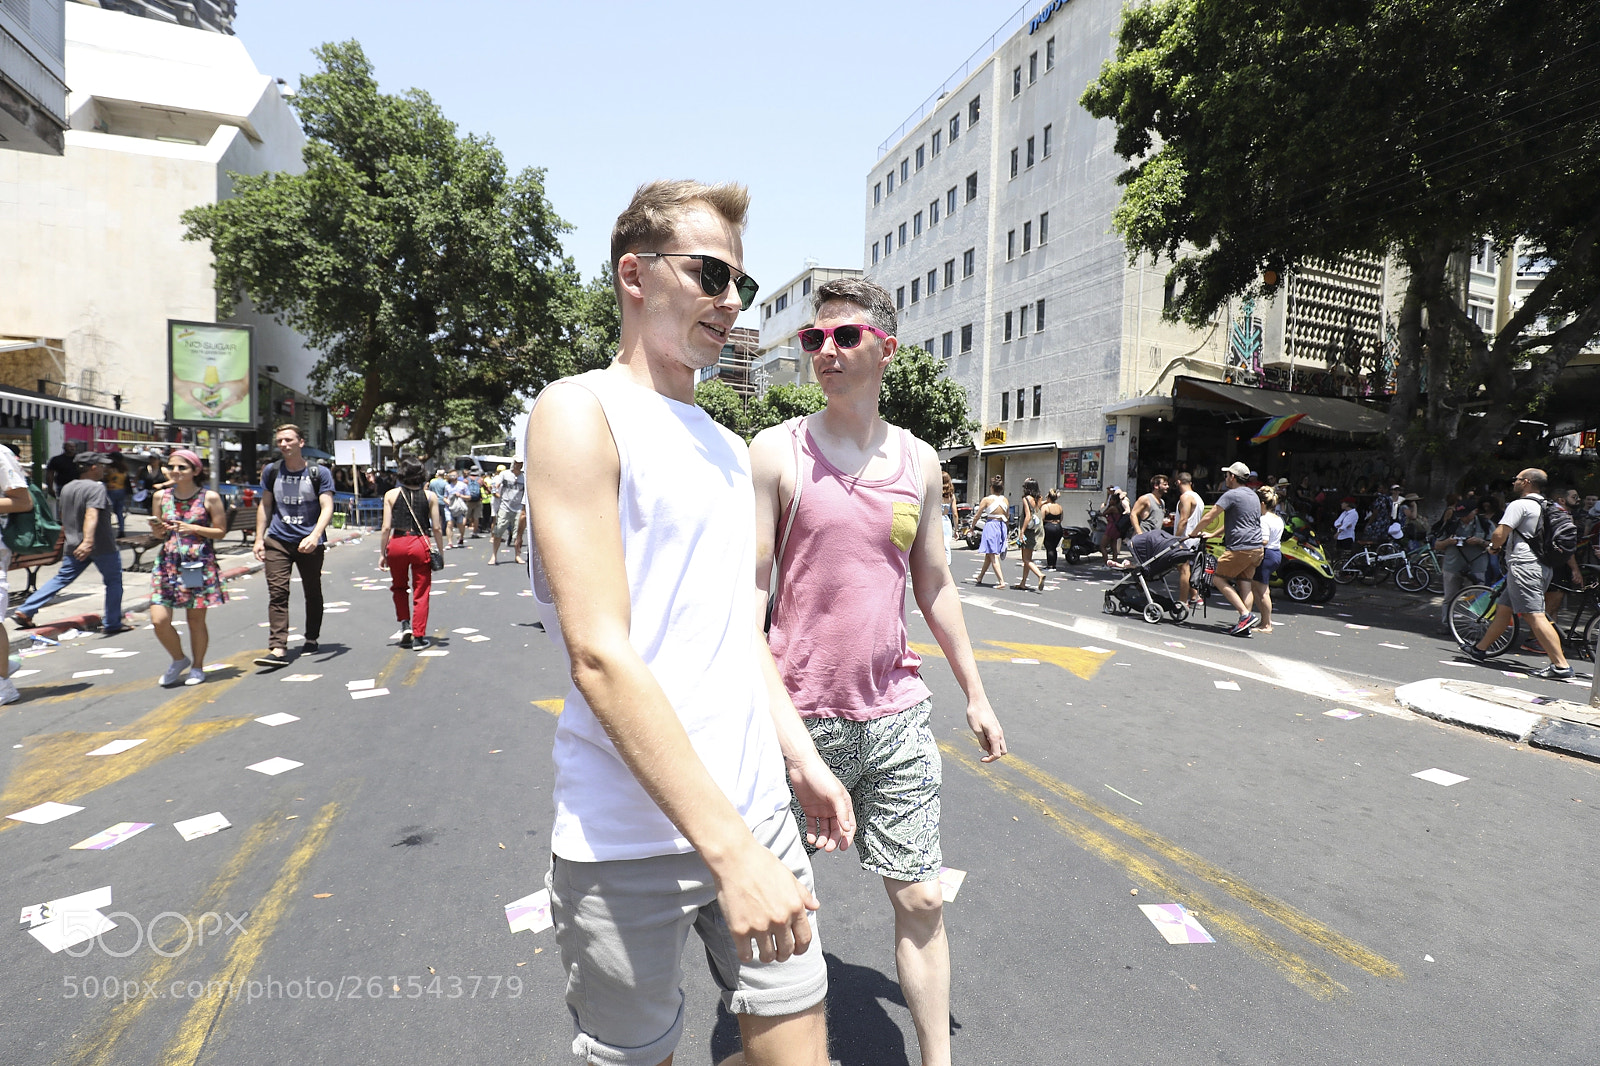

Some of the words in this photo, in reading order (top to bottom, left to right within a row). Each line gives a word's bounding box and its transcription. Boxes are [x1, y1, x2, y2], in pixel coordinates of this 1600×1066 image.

[184, 340, 202, 348] NO
[203, 341, 238, 351] SUGAR
[282, 495, 305, 505] GET
